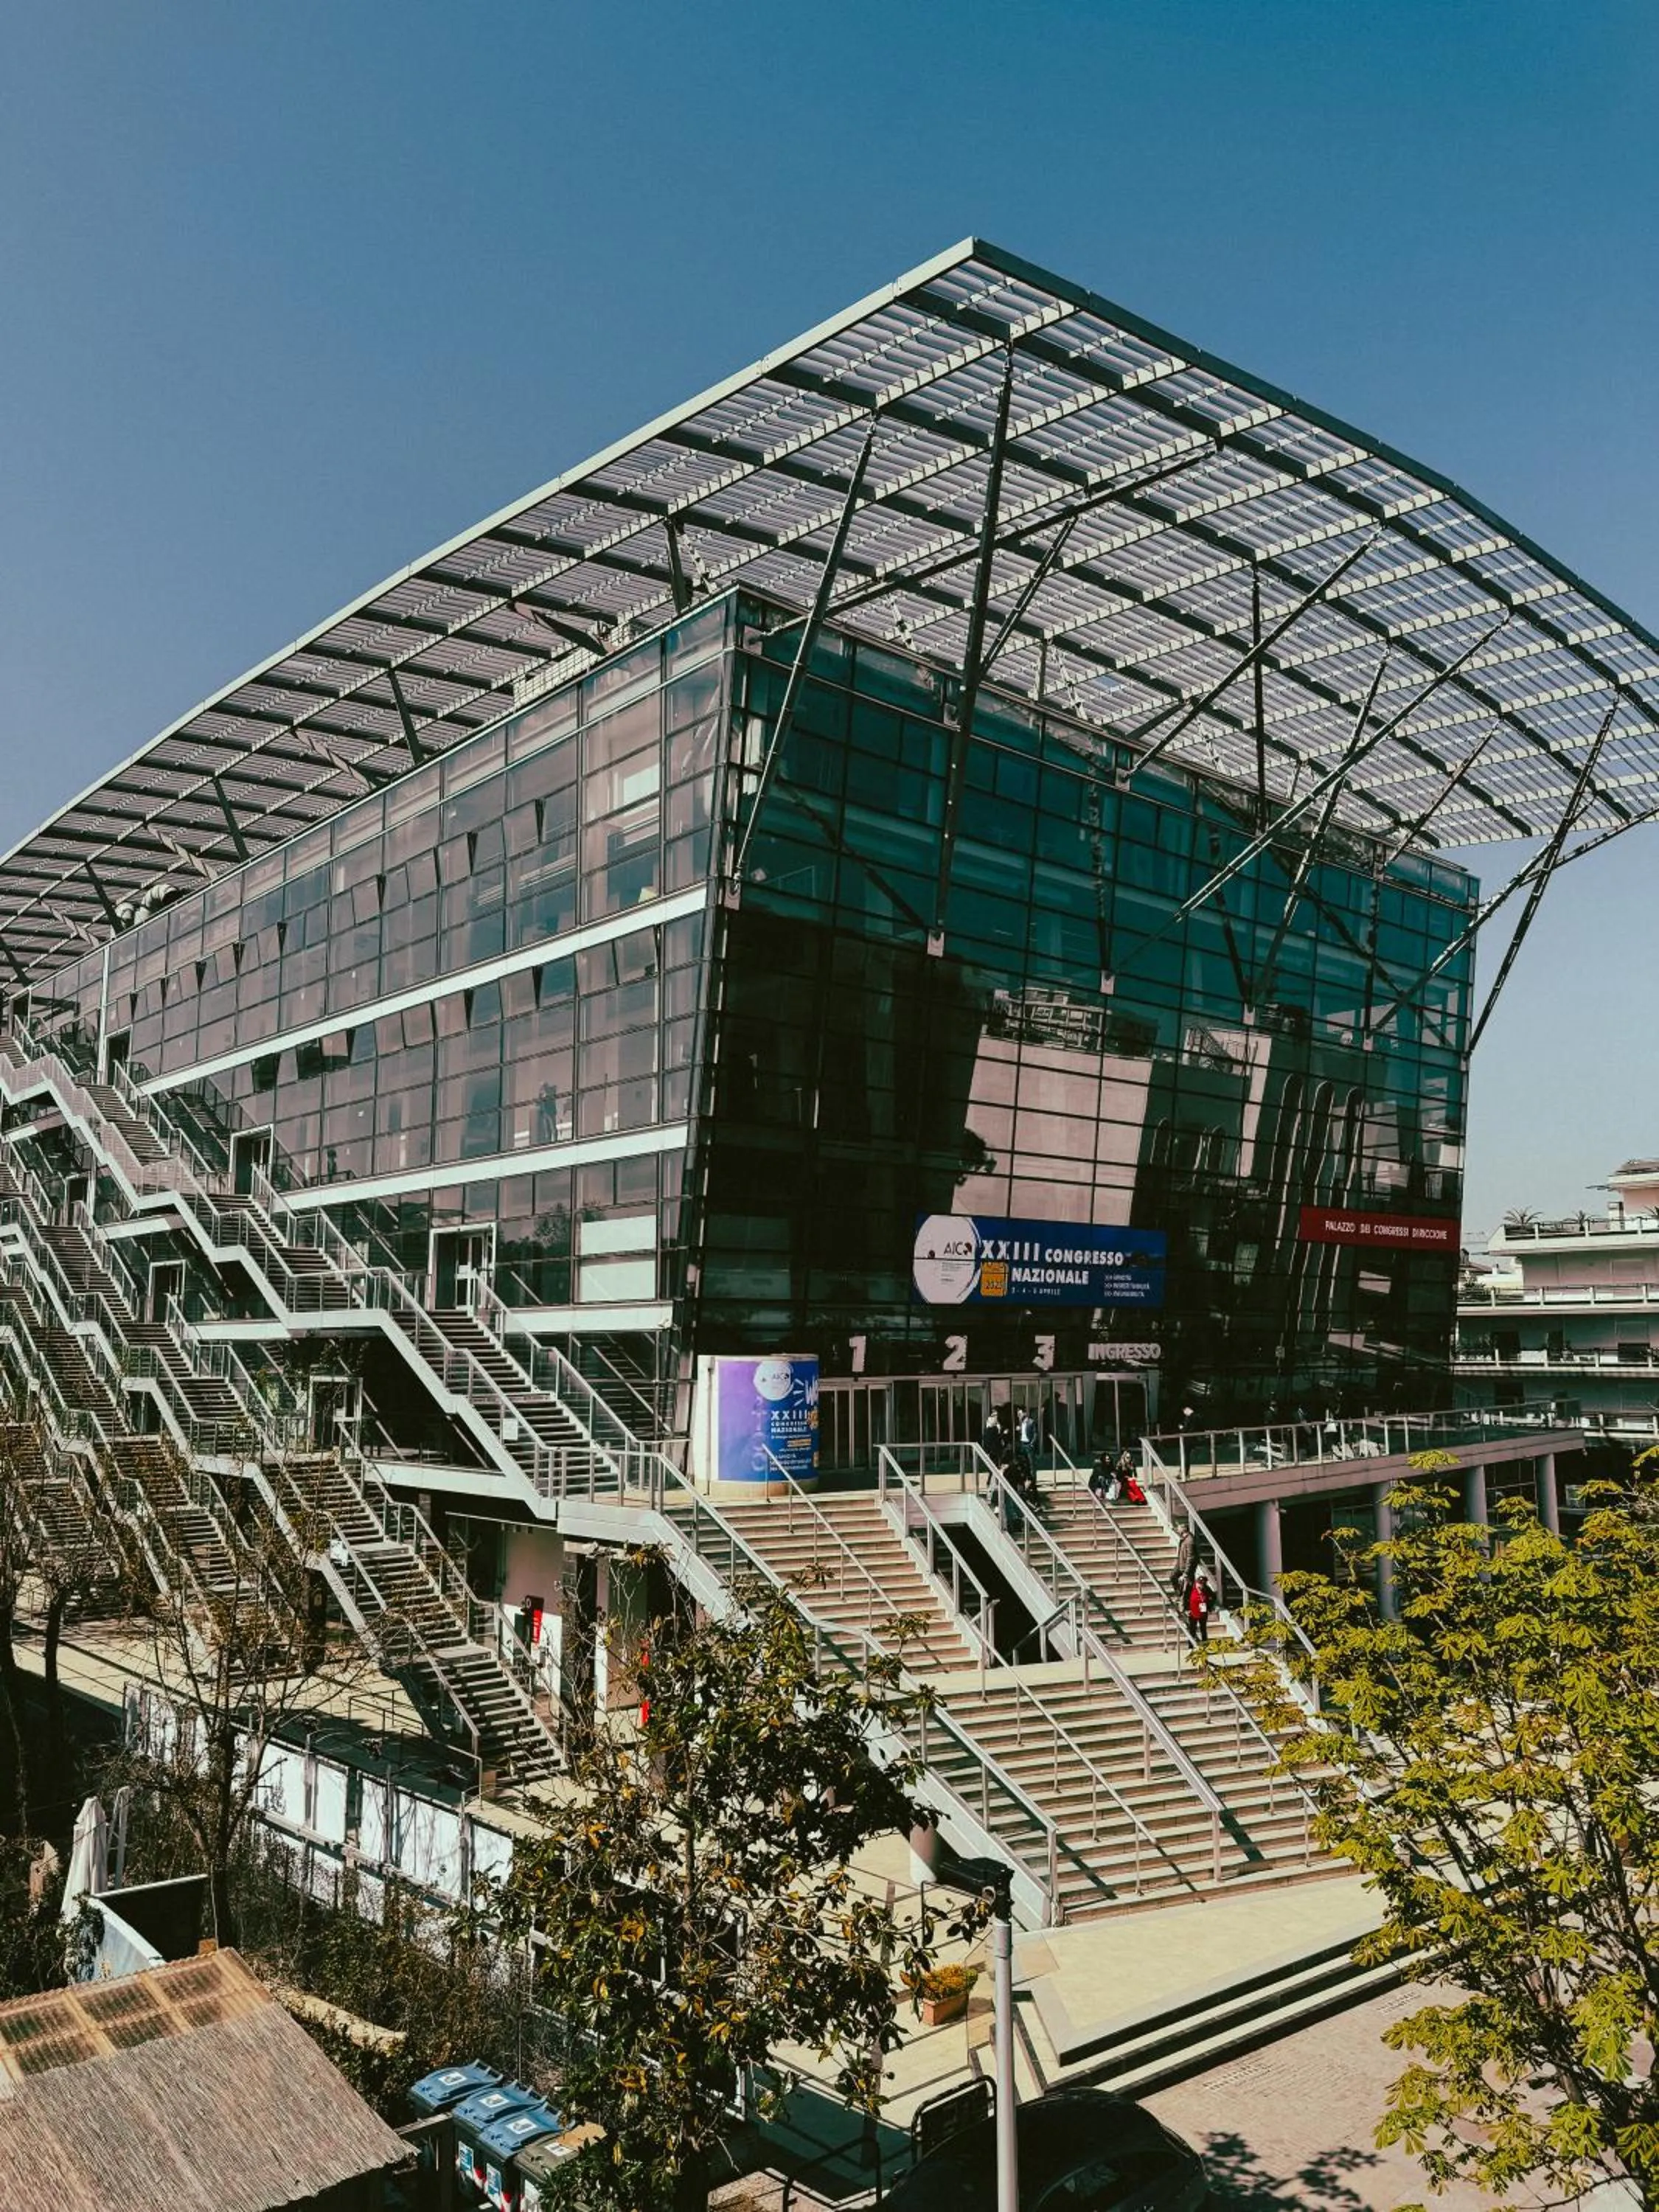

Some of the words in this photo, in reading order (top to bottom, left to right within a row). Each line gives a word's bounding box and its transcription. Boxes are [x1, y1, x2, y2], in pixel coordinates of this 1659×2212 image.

[1325, 1220, 1356, 1233] PALAZZO
[1374, 1225, 1409, 1237] CONGRESSI
[981, 1239, 1040, 1262] XXIII
[1045, 1248, 1124, 1266] CONGRESSO
[1011, 1267, 1089, 1284] NAZIONALE
[849, 1335, 866, 1372] 1
[943, 1335, 968, 1371] 2
[1032, 1335, 1055, 1371] 3
[1088, 1343, 1161, 1360] INGRESSO
